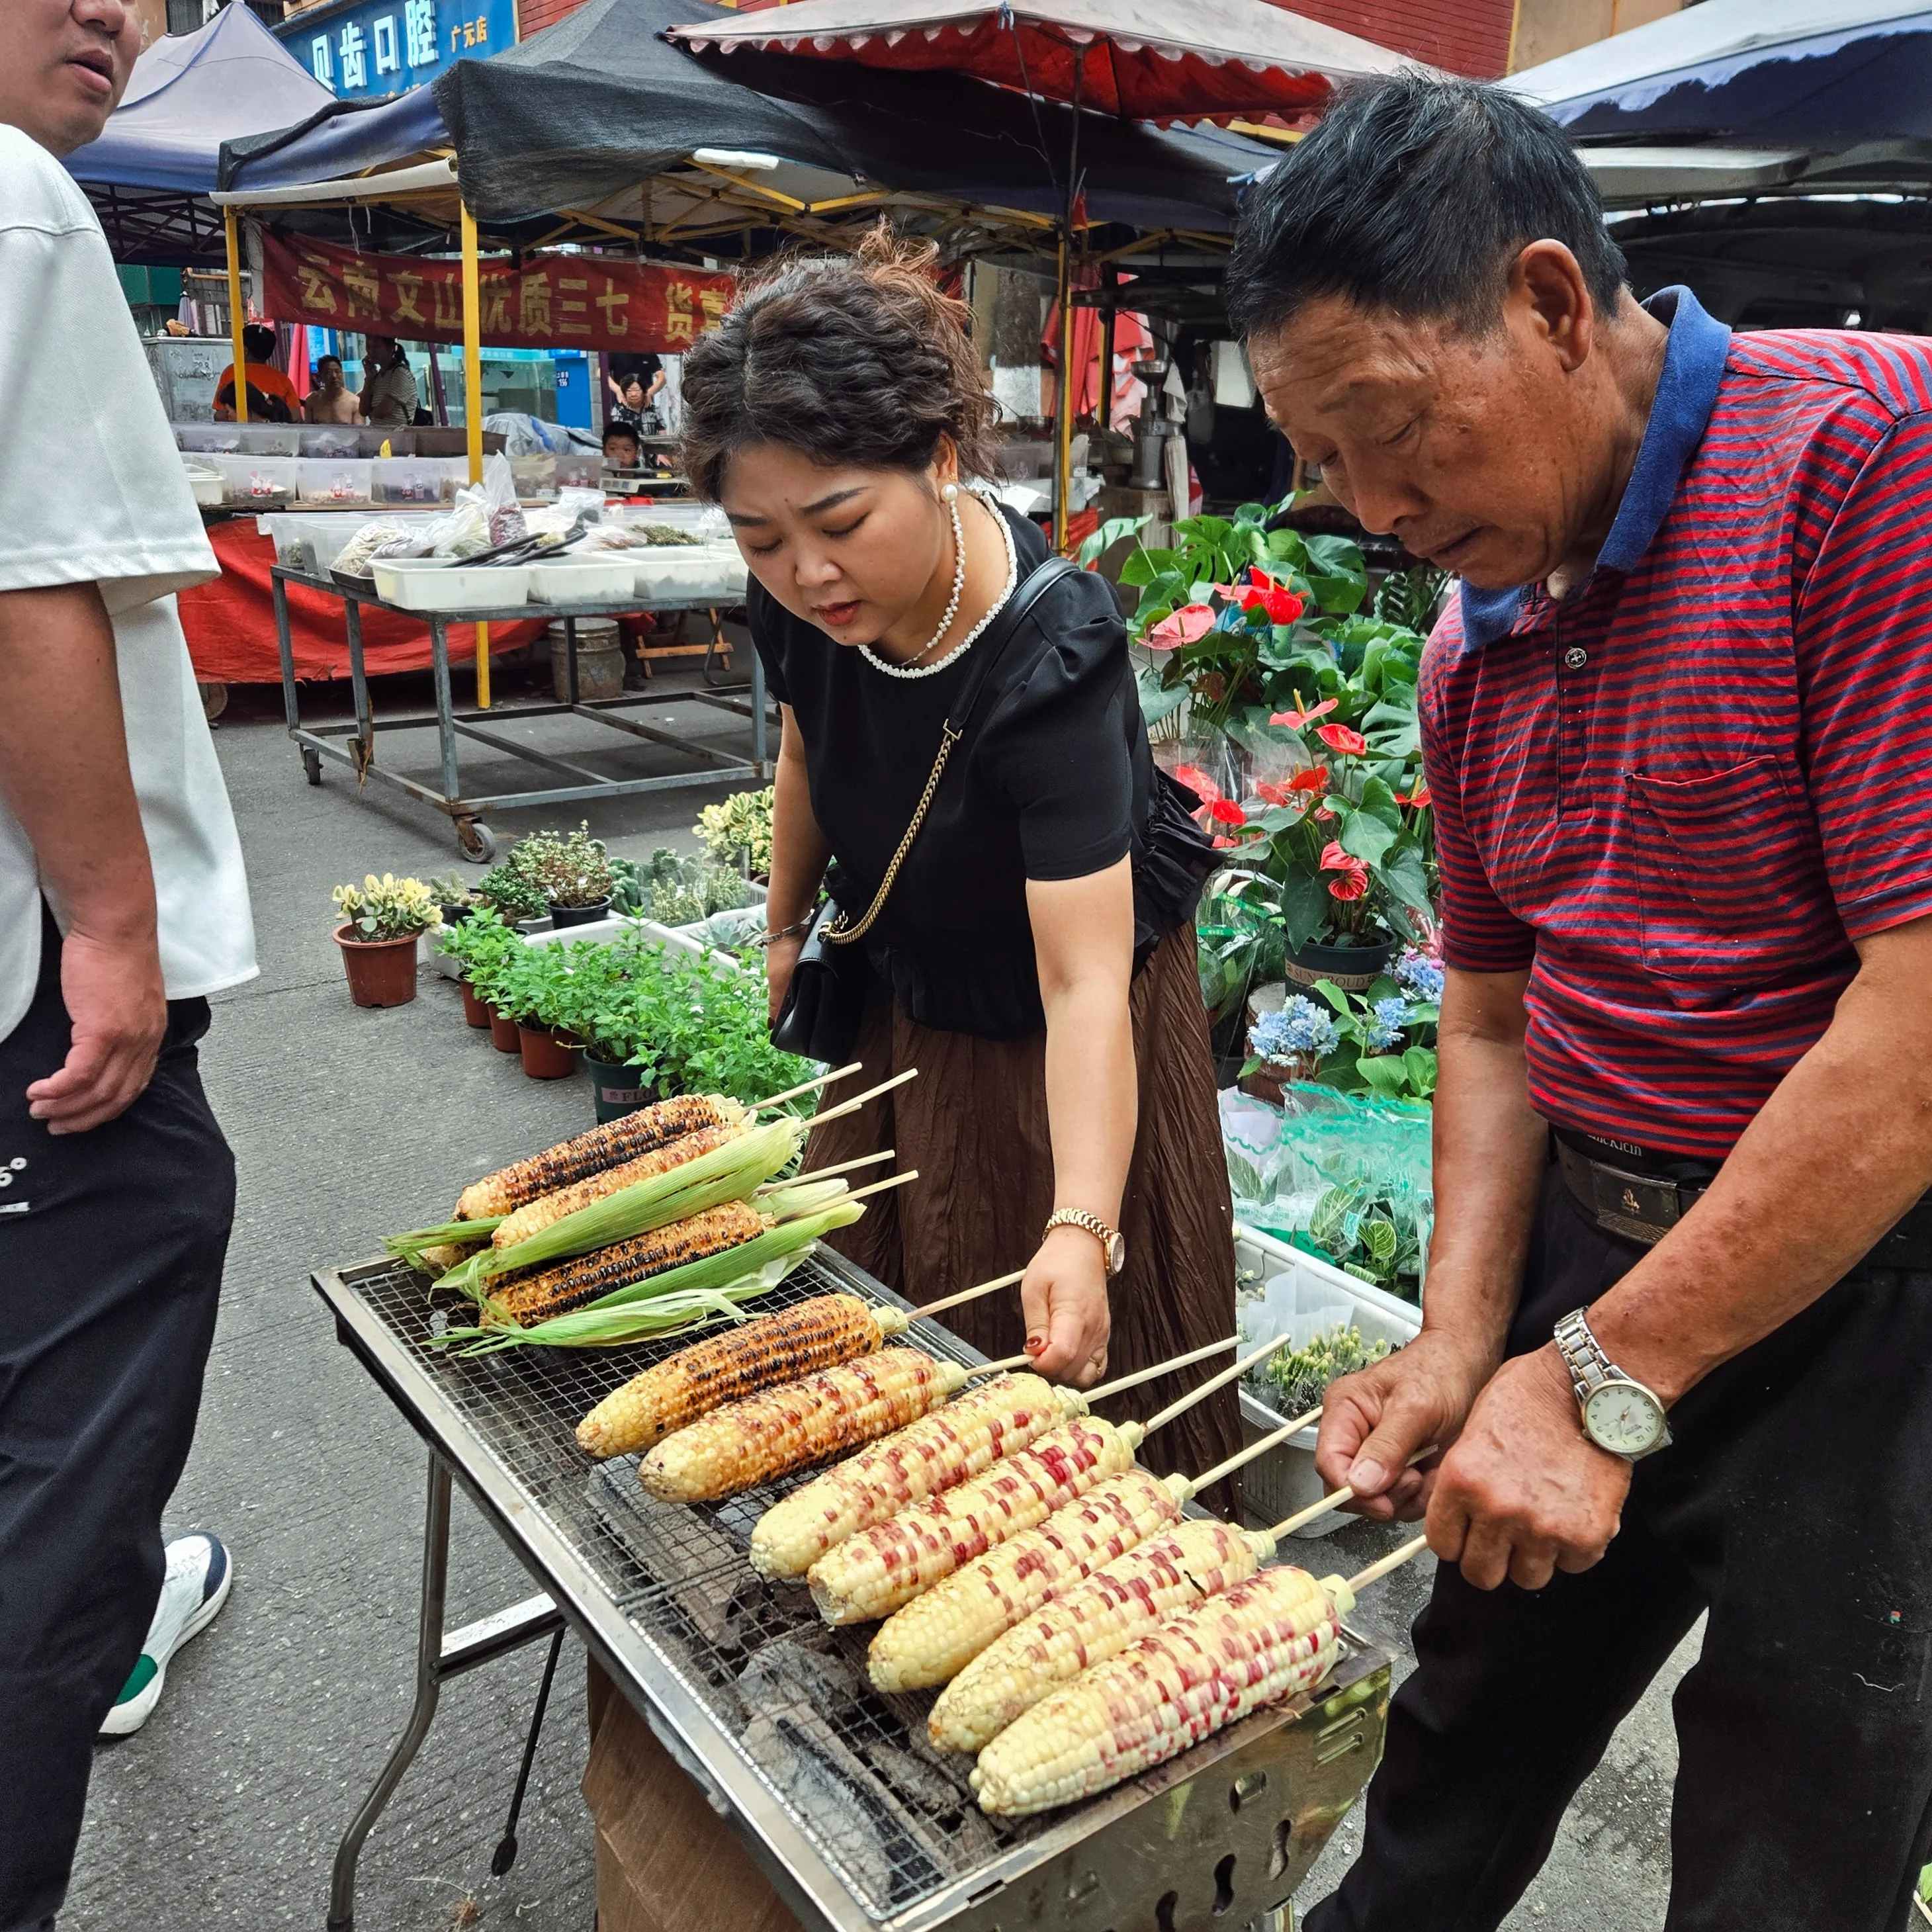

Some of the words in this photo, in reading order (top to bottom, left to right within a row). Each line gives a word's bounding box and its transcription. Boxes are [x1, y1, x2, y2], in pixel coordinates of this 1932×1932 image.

[312, 0, 439, 93] 贝齿口腔
[451, 16, 488, 53] 广元店
[298, 253, 629, 337] 云南文山优质三七
